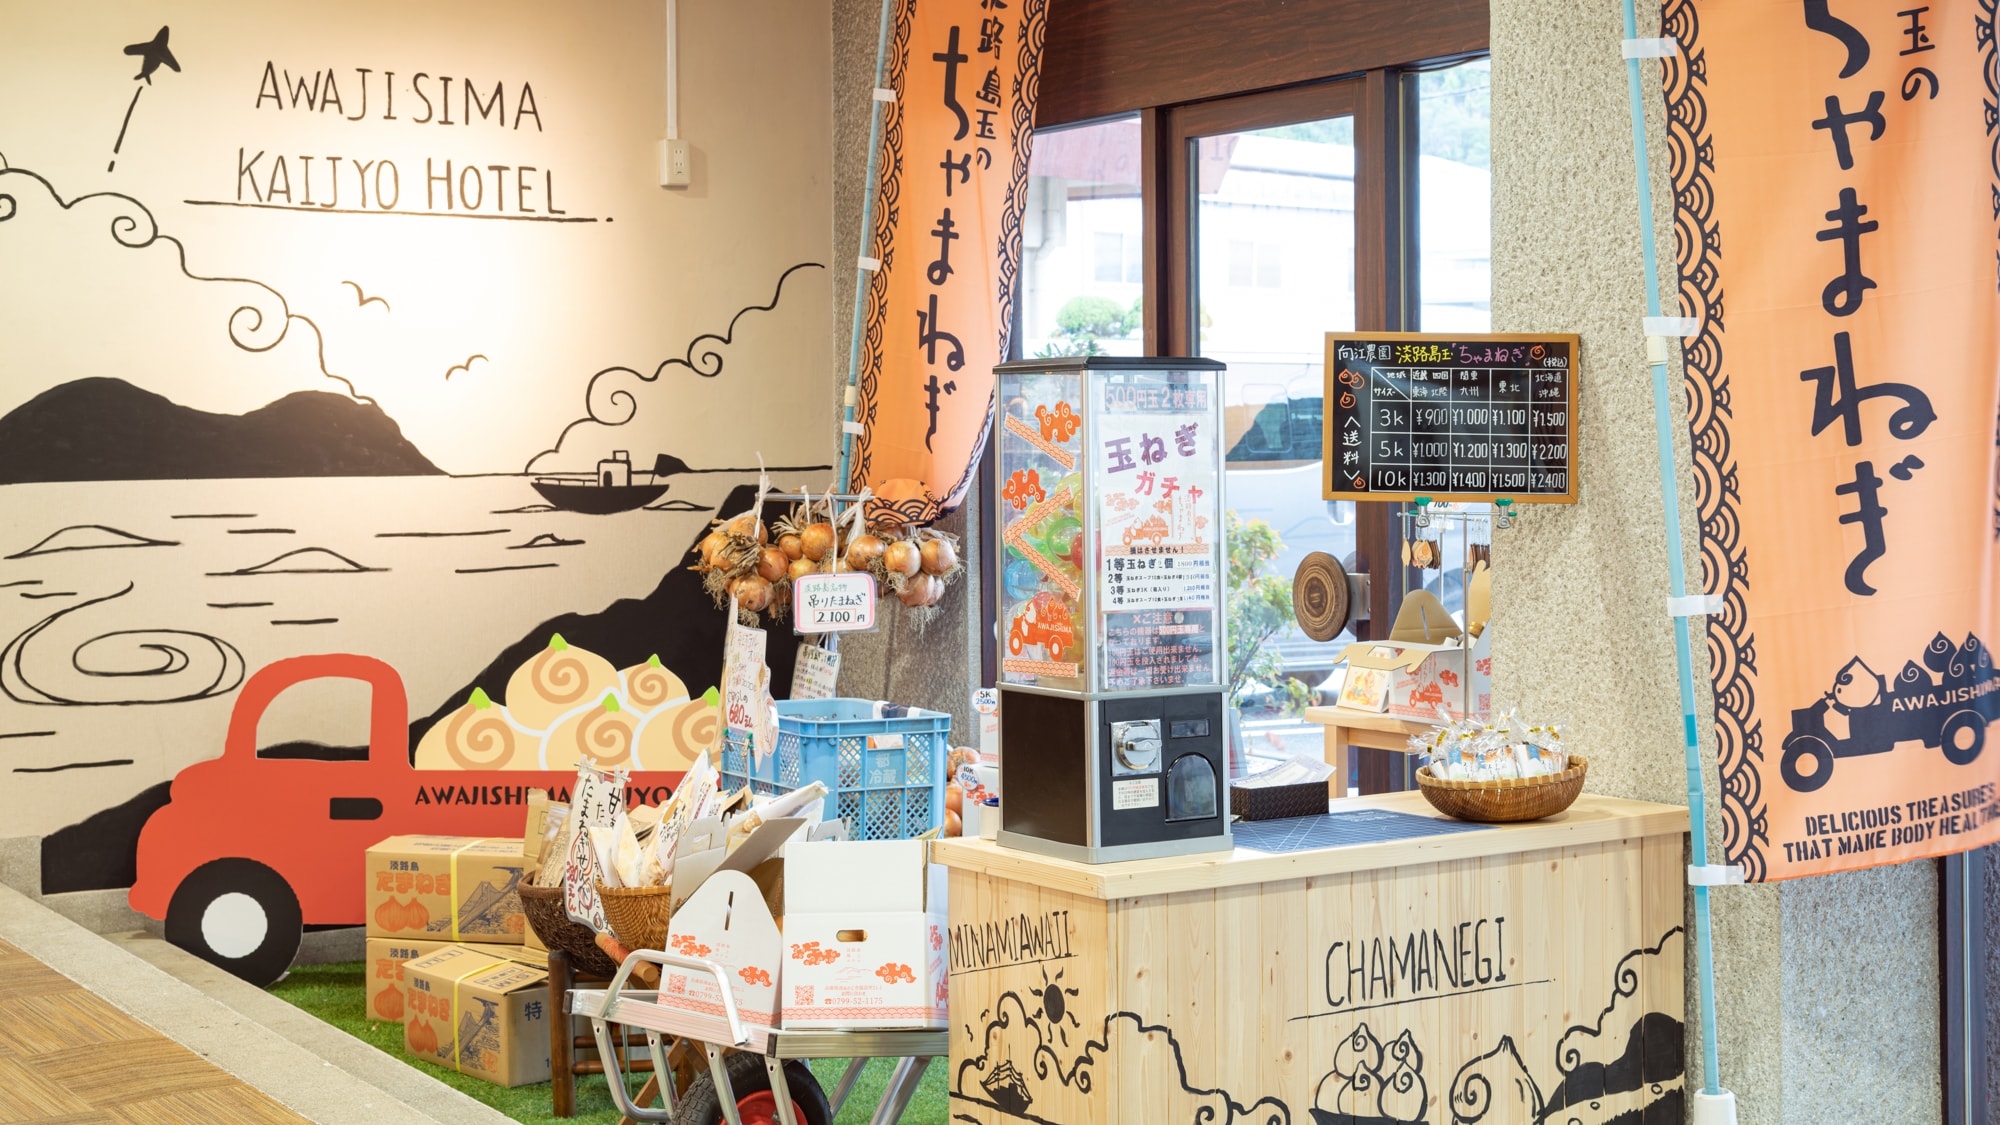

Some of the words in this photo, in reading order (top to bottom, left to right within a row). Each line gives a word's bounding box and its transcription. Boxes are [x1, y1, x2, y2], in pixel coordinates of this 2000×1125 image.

[1896, 5, 1940, 102] 玉の
[256, 60, 543, 132] AWAJISIMA
[236, 147, 399, 210] KAIJYO
[426, 157, 567, 215] HOTEL
[916, 25, 972, 454] ちゃまねぎ
[1460, 370, 1478, 381] 関東
[1535, 372, 1562, 383] 北海道
[1105, 385, 1207, 409] 500円玉2枚専用
[1412, 386, 1428, 397] 東海
[1431, 387, 1448, 397] 北陸
[1459, 386, 1480, 397] 九州
[1538, 387, 1560, 398] 沖縄
[1415, 408, 1448, 426] ¥900
[1105, 422, 1198, 473] 玉ねぎ
[1377, 470, 1406, 487] 10k
[1134, 471, 1204, 504] ガチャ
[1106, 558, 1124, 572] 1等
[1108, 573, 1123, 584] 2等
[1110, 586, 1124, 596] 3等
[808, 592, 866, 608] 吊りたまねぎ
[1112, 597, 1124, 605] 4等
[857, 614, 865, 623] 円
[1805, 804, 1902, 837] DELICIOUS
[1906, 782, 1995, 822] TREASURES
[1783, 837, 1833, 863] THAT
[1837, 831, 1887, 856] MAKE
[1891, 820, 1935, 847] BODY
[389, 860, 420, 872] 淡路島
[948, 910, 1072, 972] MINAMIAWAJI
[389, 948, 420, 959] 淡路島
[1325, 917, 1506, 1007] CHAMANEGI
[413, 977, 431, 992] 淡路島
[407, 987, 451, 1022] たまねぎ
[832, 997, 884, 1006] 0799-52-1175
